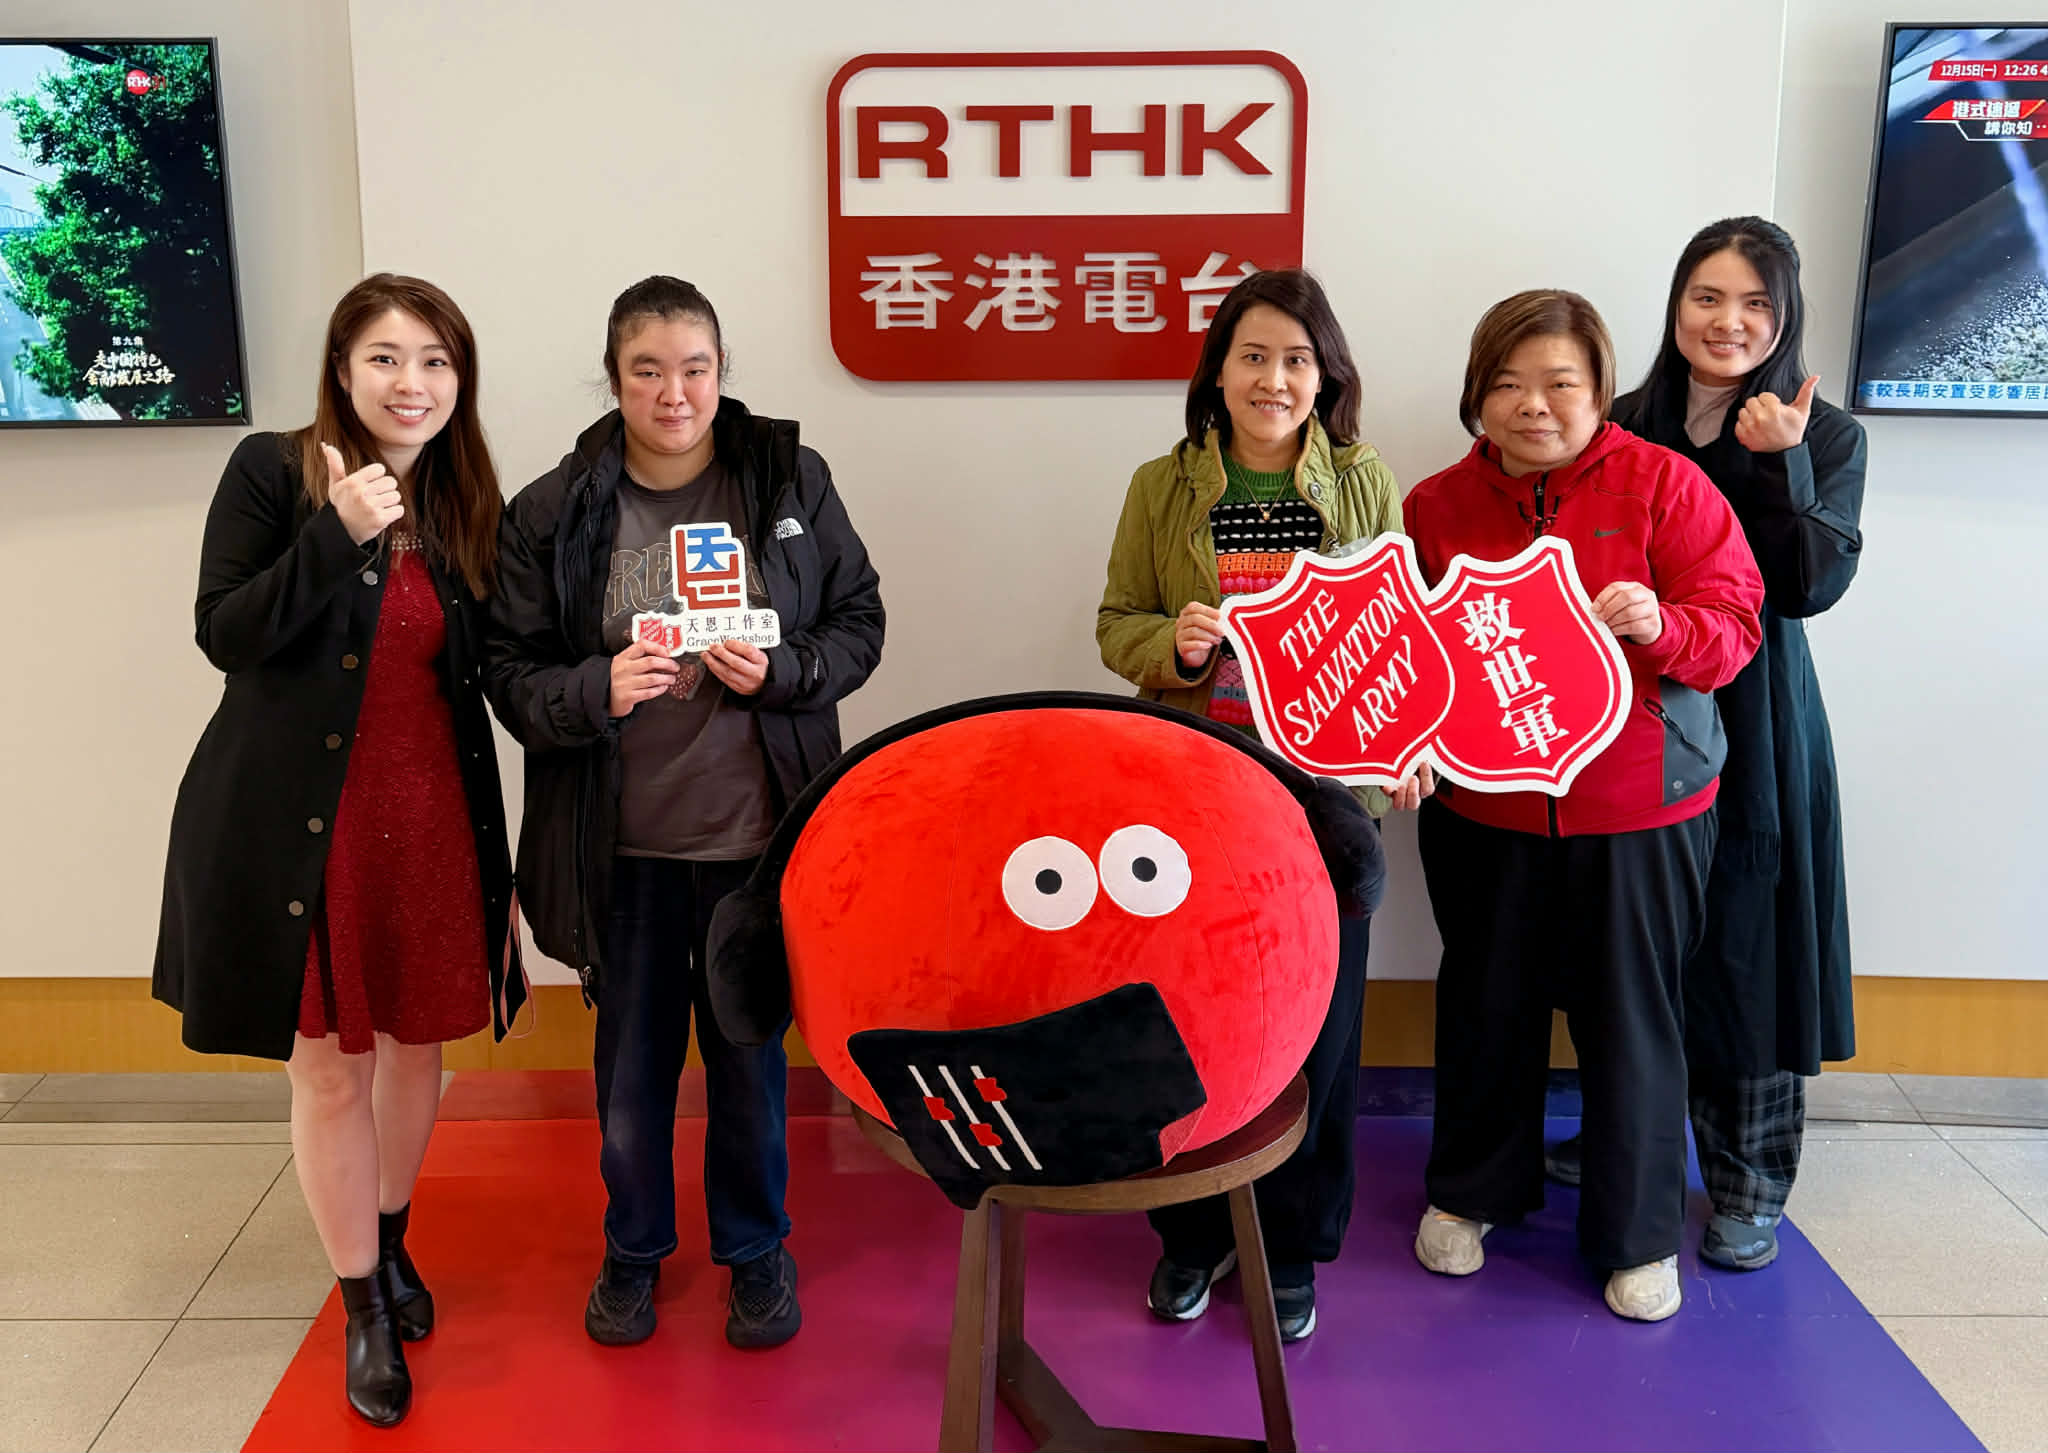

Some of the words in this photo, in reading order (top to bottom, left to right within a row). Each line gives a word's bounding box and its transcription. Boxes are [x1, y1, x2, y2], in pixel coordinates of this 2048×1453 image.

[1941, 64, 1997, 78] 12月15日(一)
[2004, 64, 2038, 76] 12:26
[857, 102, 1275, 178] RTHK
[859, 252, 1262, 332] 香港電台
[687, 613, 774, 633] 天恩工作室
[1279, 589, 1340, 672] THE
[1284, 571, 1408, 747] SALVATION
[1351, 635, 1419, 754] ARMY
[1456, 592, 1570, 759] 救世軍
